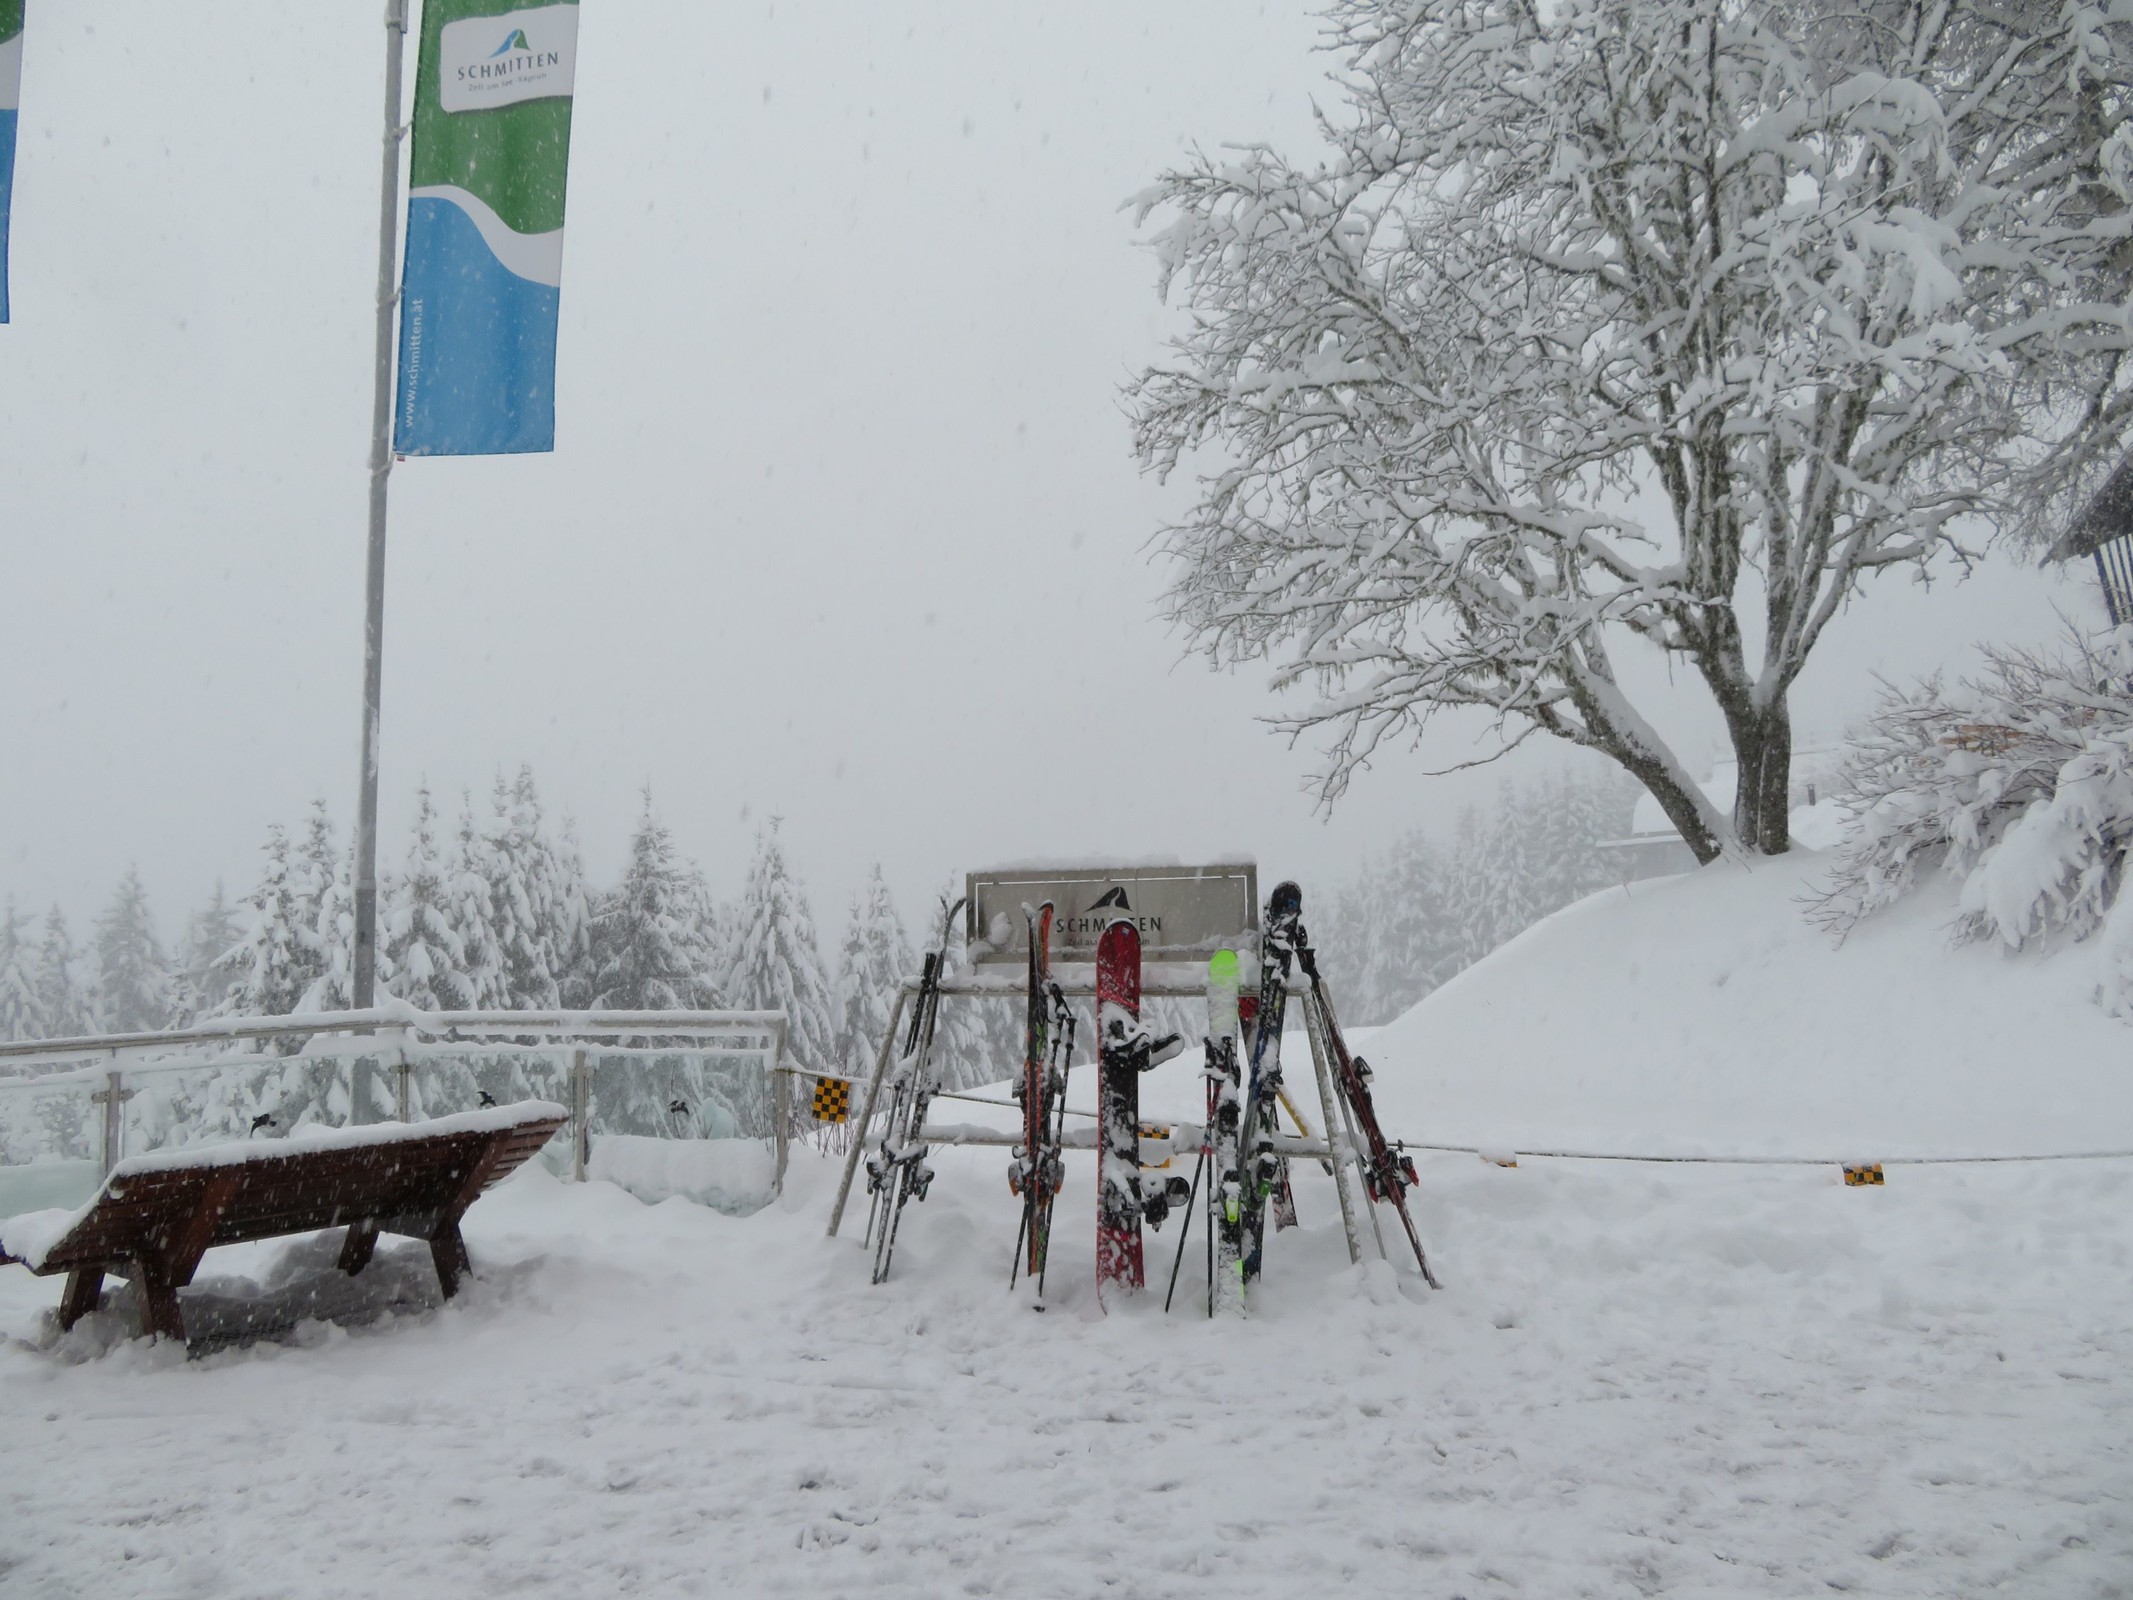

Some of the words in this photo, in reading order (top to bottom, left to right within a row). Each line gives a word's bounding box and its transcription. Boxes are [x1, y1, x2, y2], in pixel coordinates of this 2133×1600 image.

[457, 51, 558, 81] SCHMITTEN
[405, 298, 424, 428] www.schmitten.at
[1056, 917, 1161, 933] SCHMEN
